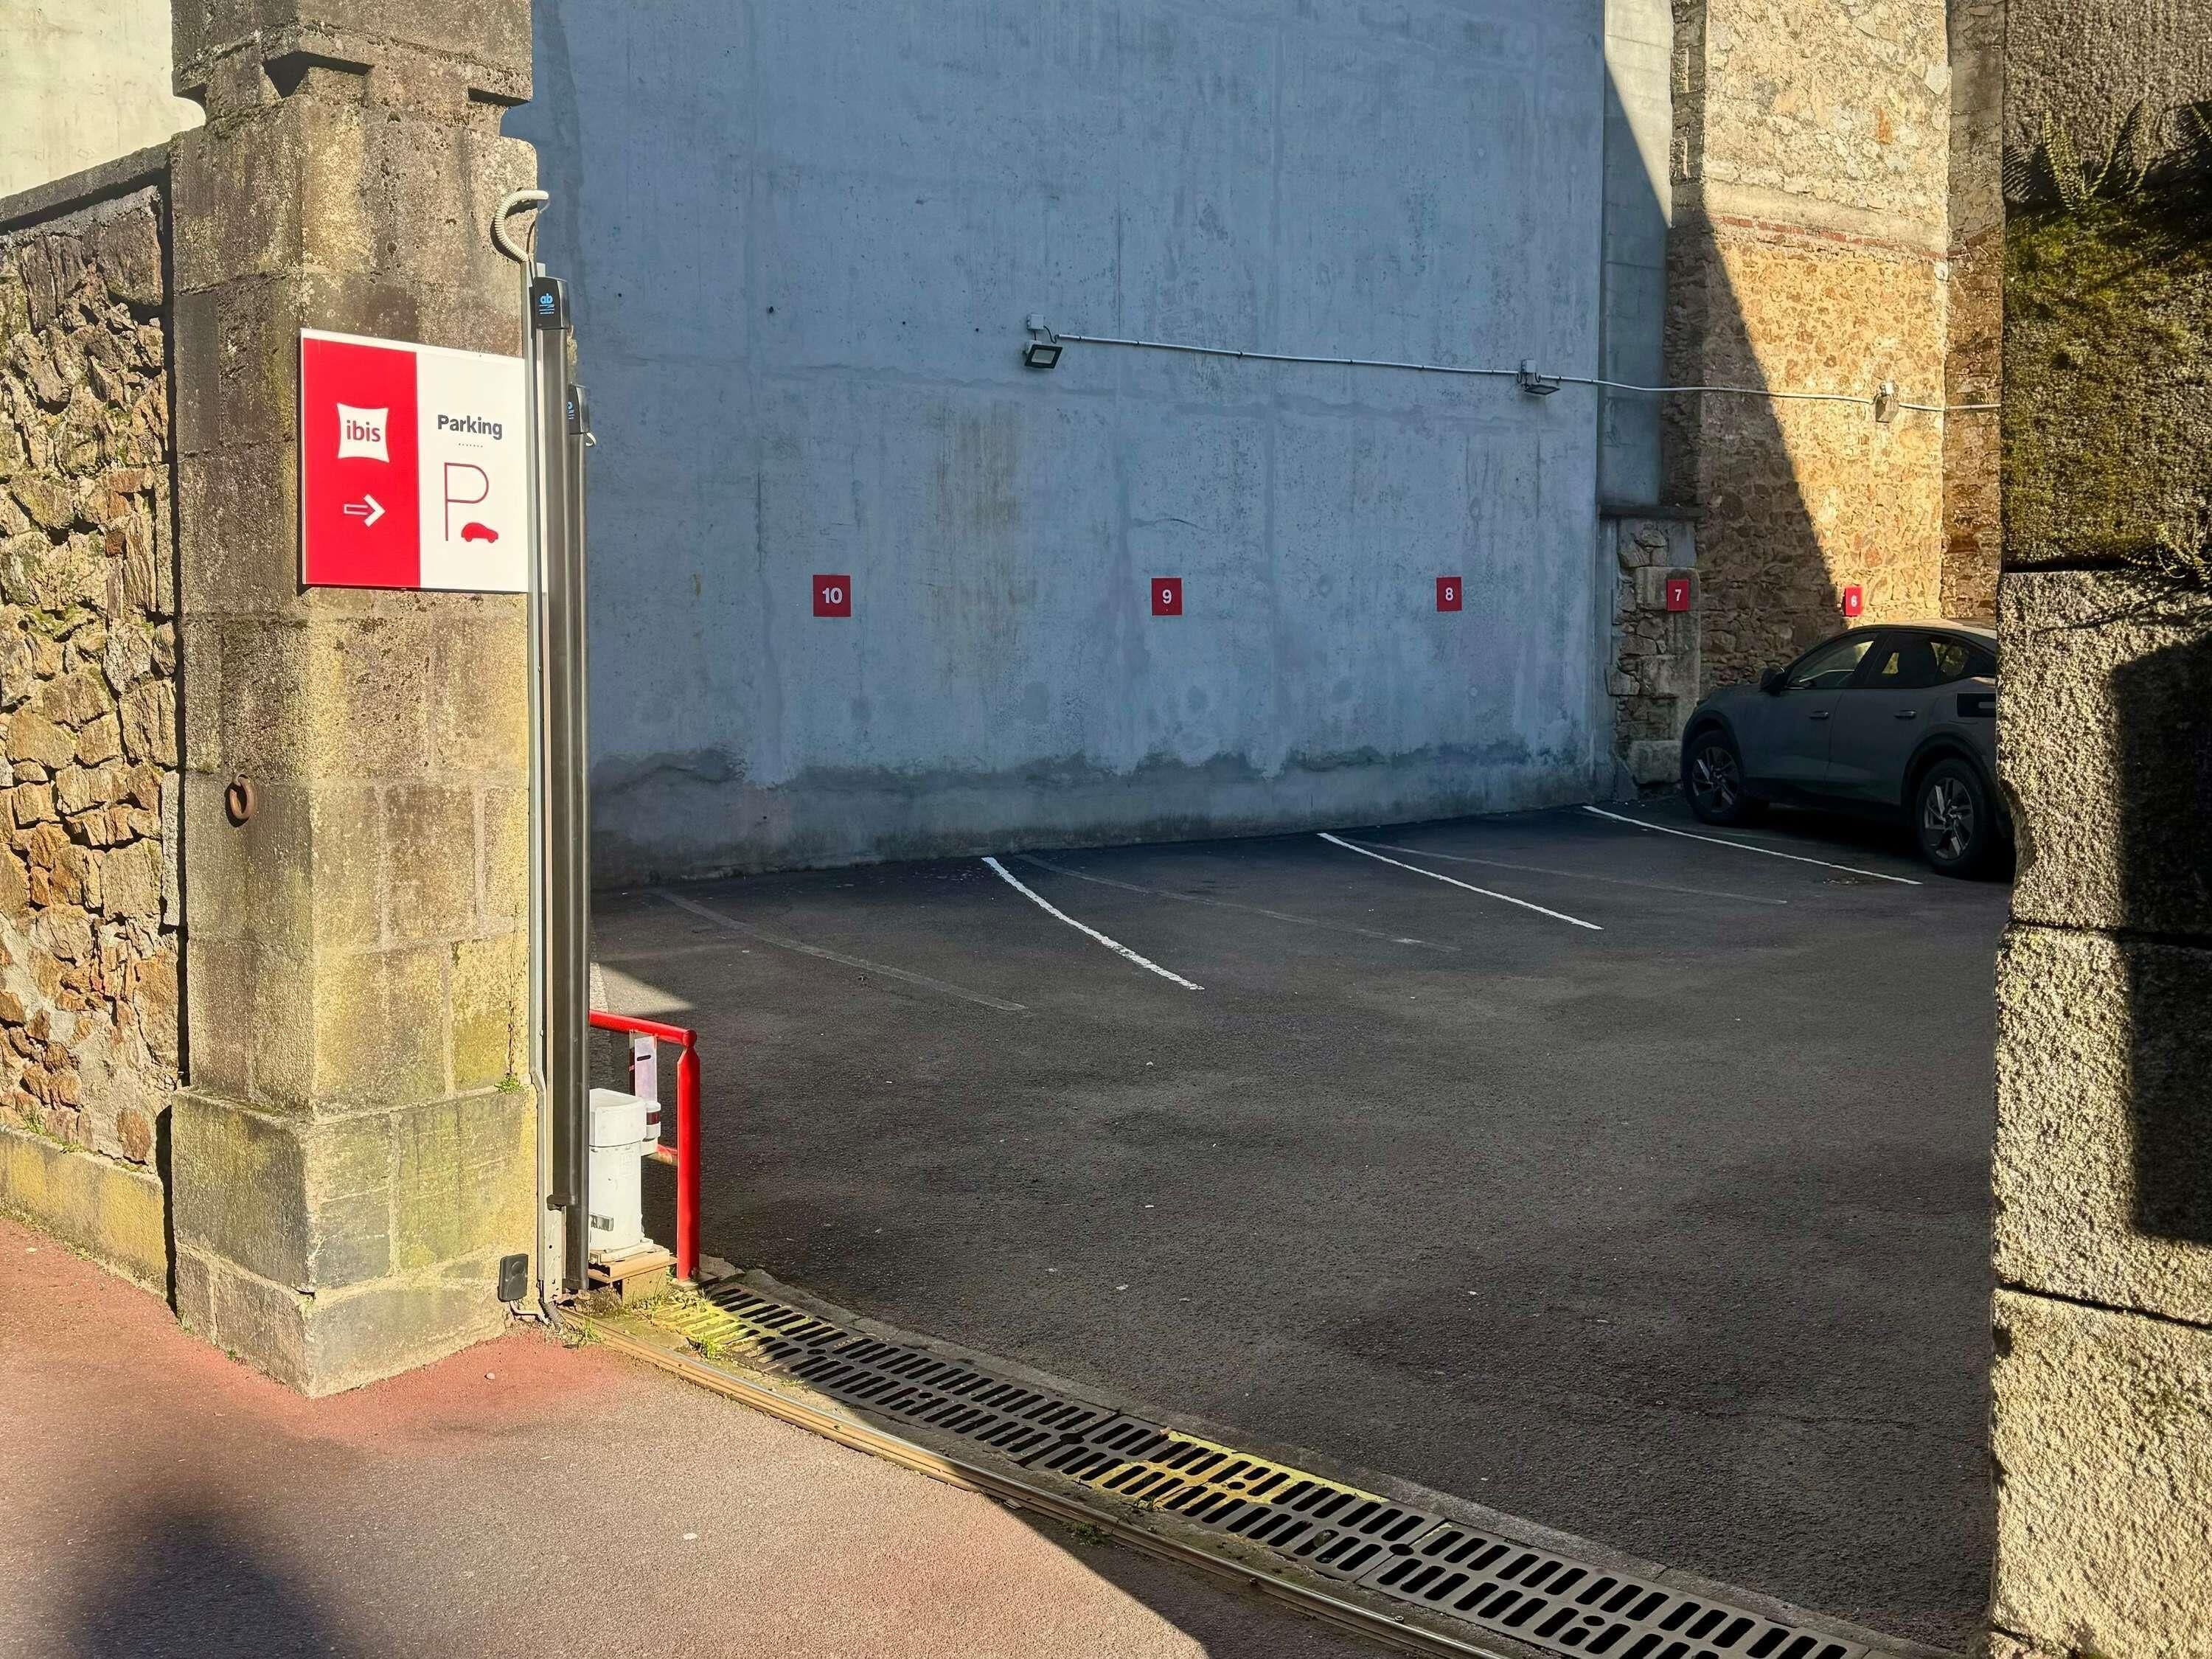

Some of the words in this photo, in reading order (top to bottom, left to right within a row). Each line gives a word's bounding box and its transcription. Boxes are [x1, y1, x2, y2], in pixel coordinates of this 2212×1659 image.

[346, 420, 381, 442] ibis
[437, 414, 503, 440] Parking
[444, 462, 489, 541] P
[822, 587, 843, 604] 10
[1162, 589, 1172, 605] 9
[1445, 587, 1453, 601] 8
[1674, 588, 1682, 602] 7
